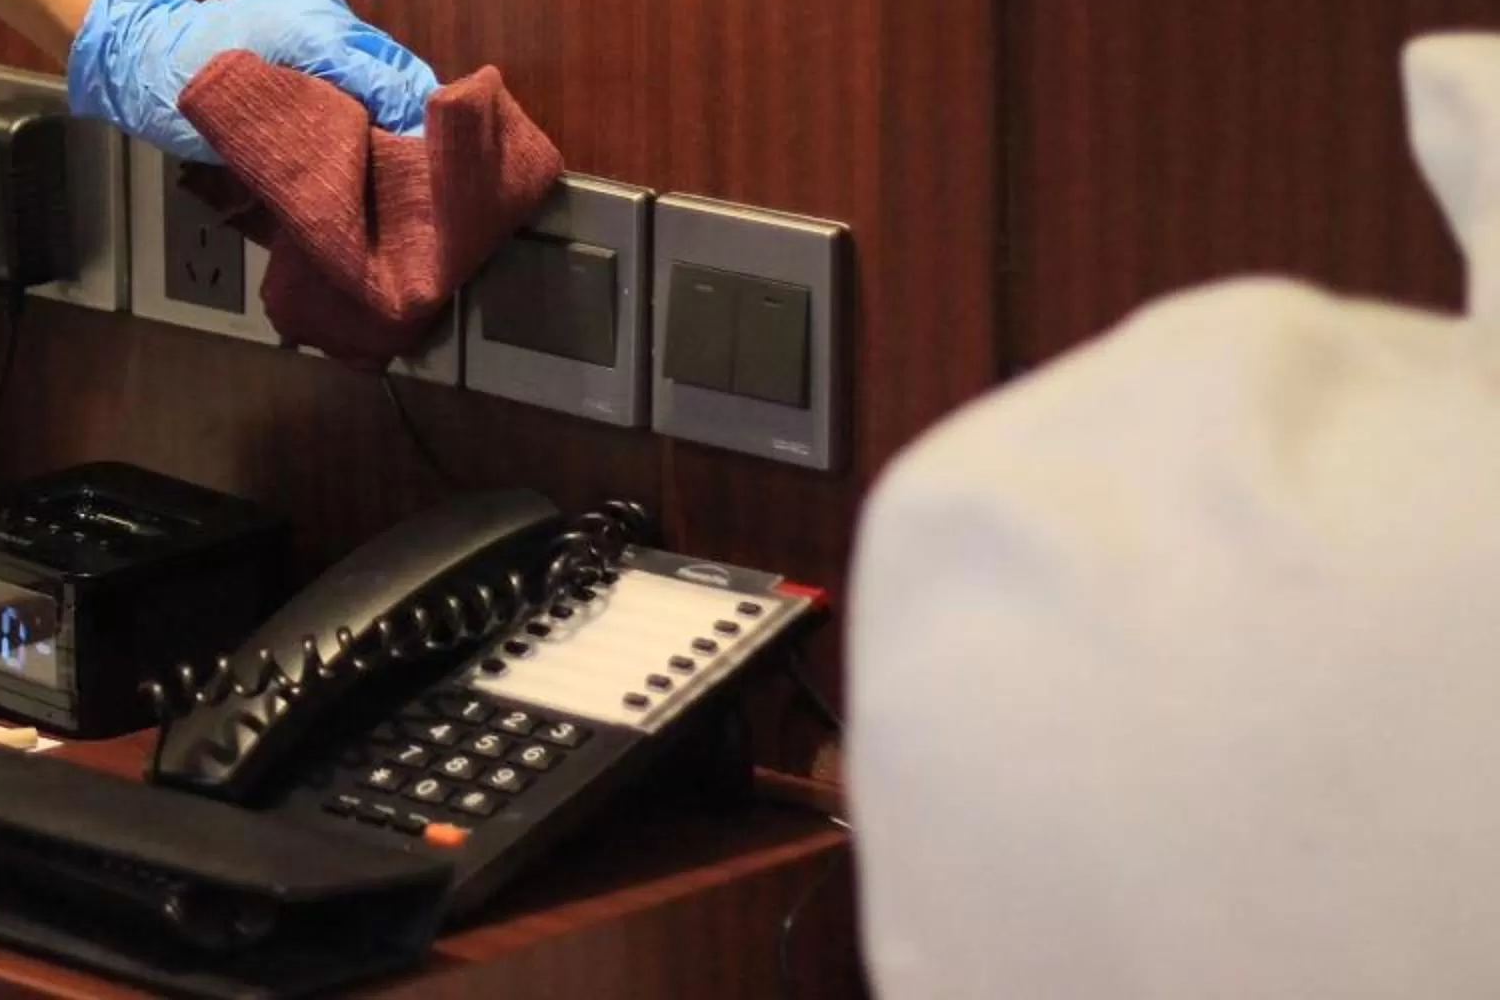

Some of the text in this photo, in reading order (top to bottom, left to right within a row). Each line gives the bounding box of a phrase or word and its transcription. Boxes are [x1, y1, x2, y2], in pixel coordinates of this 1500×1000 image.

[461, 701, 576, 739] 1 2 3
[429, 723, 546, 762] 4 5 6
[398, 745, 516, 785] 7 8 9
[414, 778, 438, 795] 0
